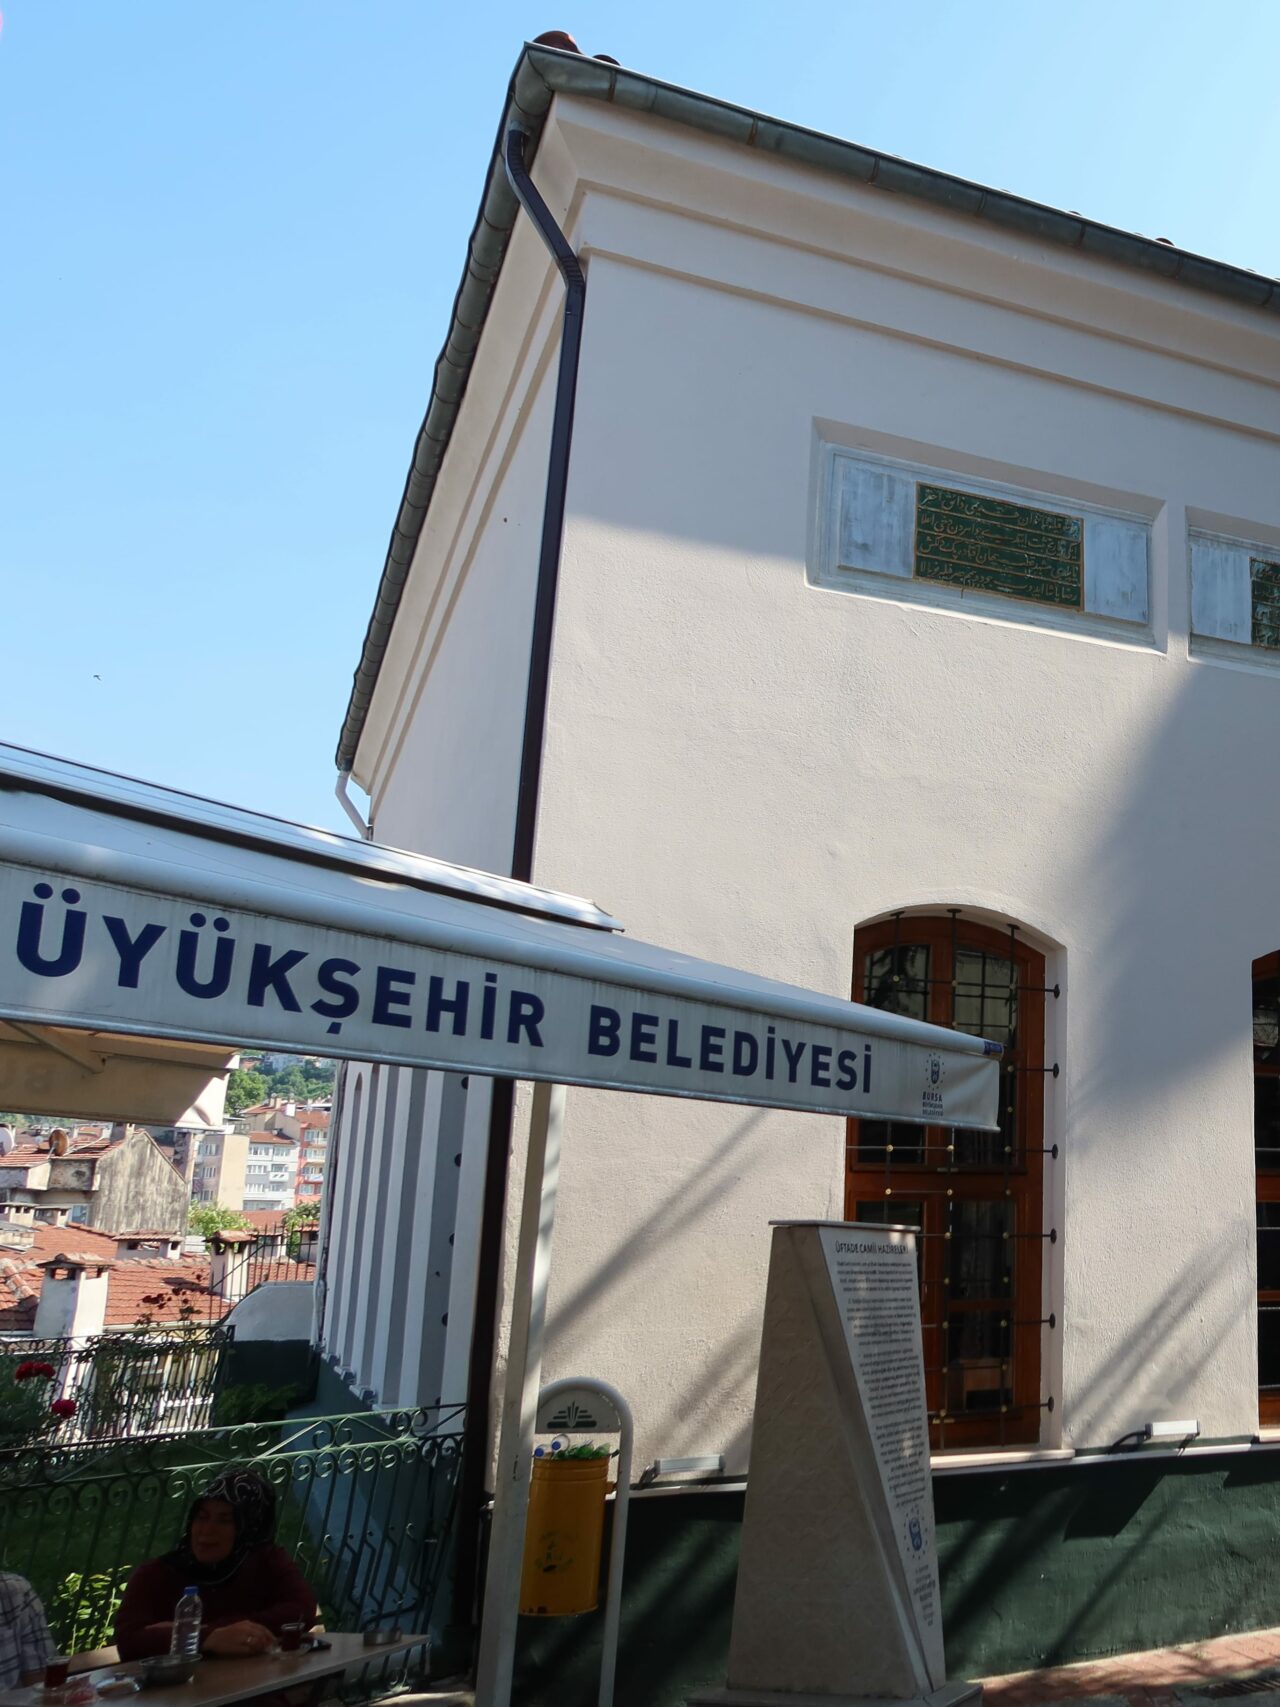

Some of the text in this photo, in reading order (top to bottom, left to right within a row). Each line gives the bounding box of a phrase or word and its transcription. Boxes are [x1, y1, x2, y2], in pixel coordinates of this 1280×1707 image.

[16, 882, 873, 1094] ÜYÜKŞEHİR BELEDİYESİ
[922, 1091, 943, 1102] BURSA
